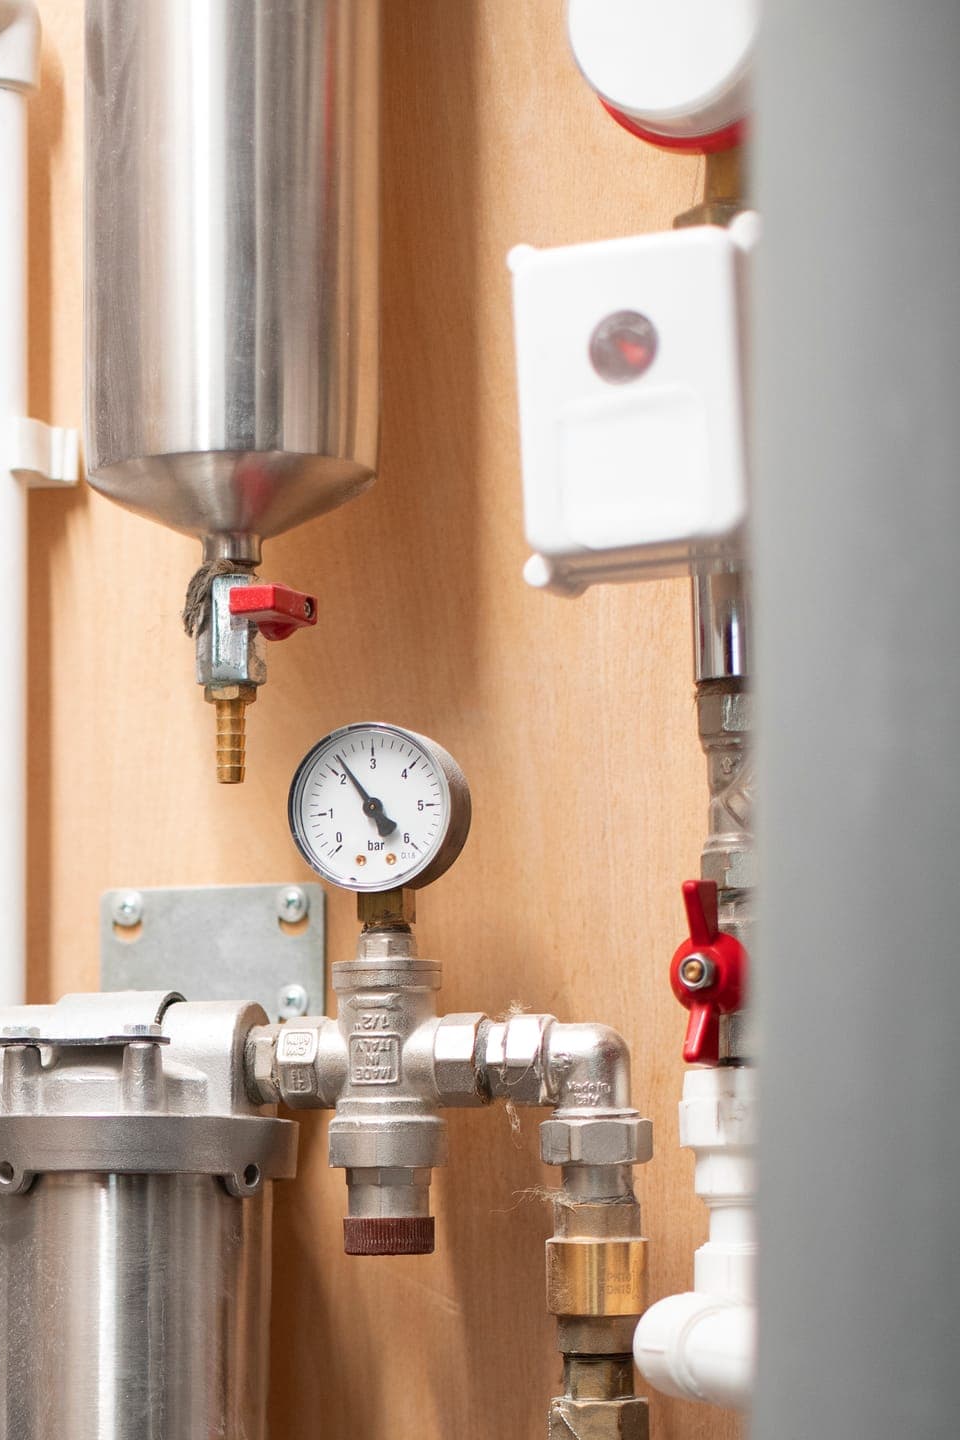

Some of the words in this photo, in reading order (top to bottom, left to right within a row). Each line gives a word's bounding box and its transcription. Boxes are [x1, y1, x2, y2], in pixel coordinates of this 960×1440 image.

[370, 758, 377, 770] 3
[401, 769, 408, 779] 4
[340, 775, 347, 785] 2
[417, 800, 424, 811] 5
[328, 808, 334, 819] 1
[336, 832, 342, 843] 0
[403, 833, 410, 844] 6
[367, 839, 385, 851] bar
[354, 1014, 390, 1031] 1/2"
[355, 1039, 392, 1053] ITALY
[366, 1053, 380, 1066] IN
[356, 1066, 392, 1080] MADE
